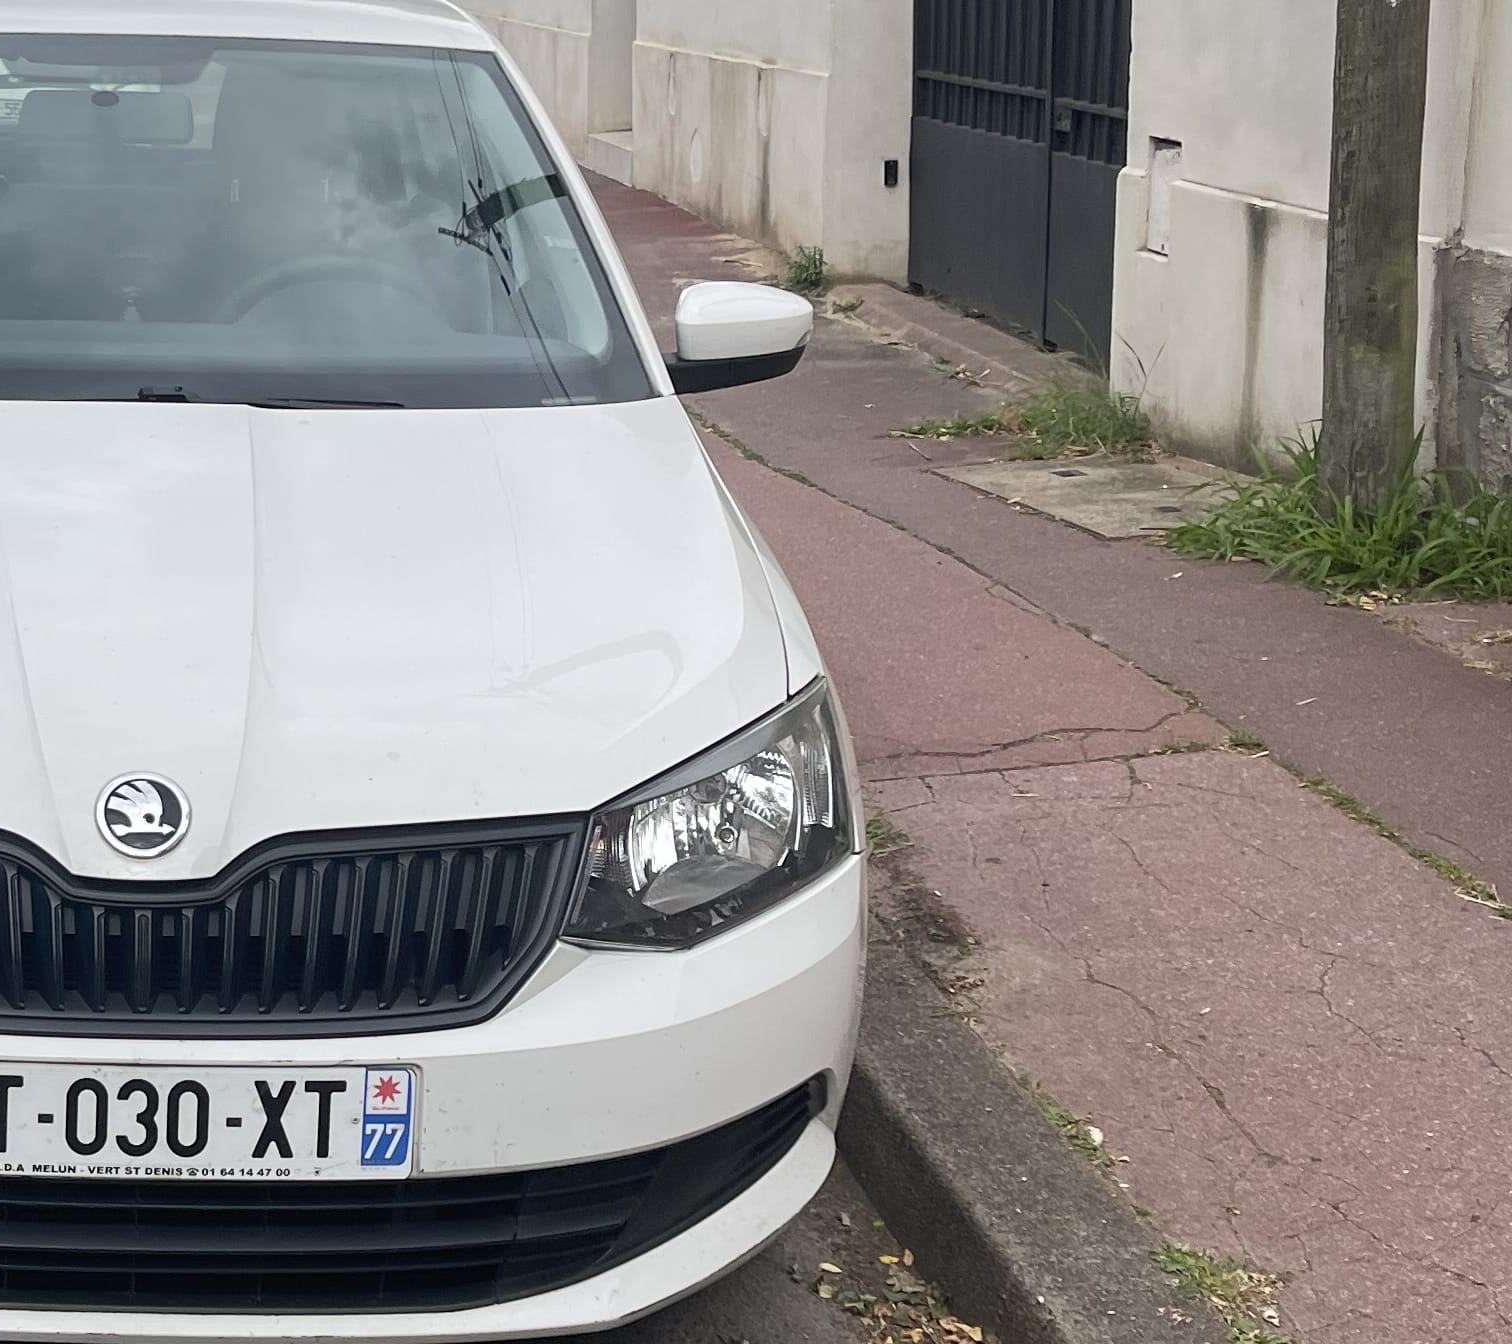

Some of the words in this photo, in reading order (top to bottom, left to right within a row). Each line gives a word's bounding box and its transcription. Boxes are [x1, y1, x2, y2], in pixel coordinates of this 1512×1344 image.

[364, 1122, 406, 1160] 77
[32, 1163, 77, 1174] MELUN
[88, 1165, 120, 1175] VERT
[125, 1166, 141, 1176] ST
[144, 1167, 183, 1177] DENIS
[201, 1168, 216, 1177] 01
[220, 1168, 235, 1177] 64
[239, 1168, 253, 1177] 14
[257, 1168, 272, 1177] 47
[276, 1168, 291, 1177] 00
